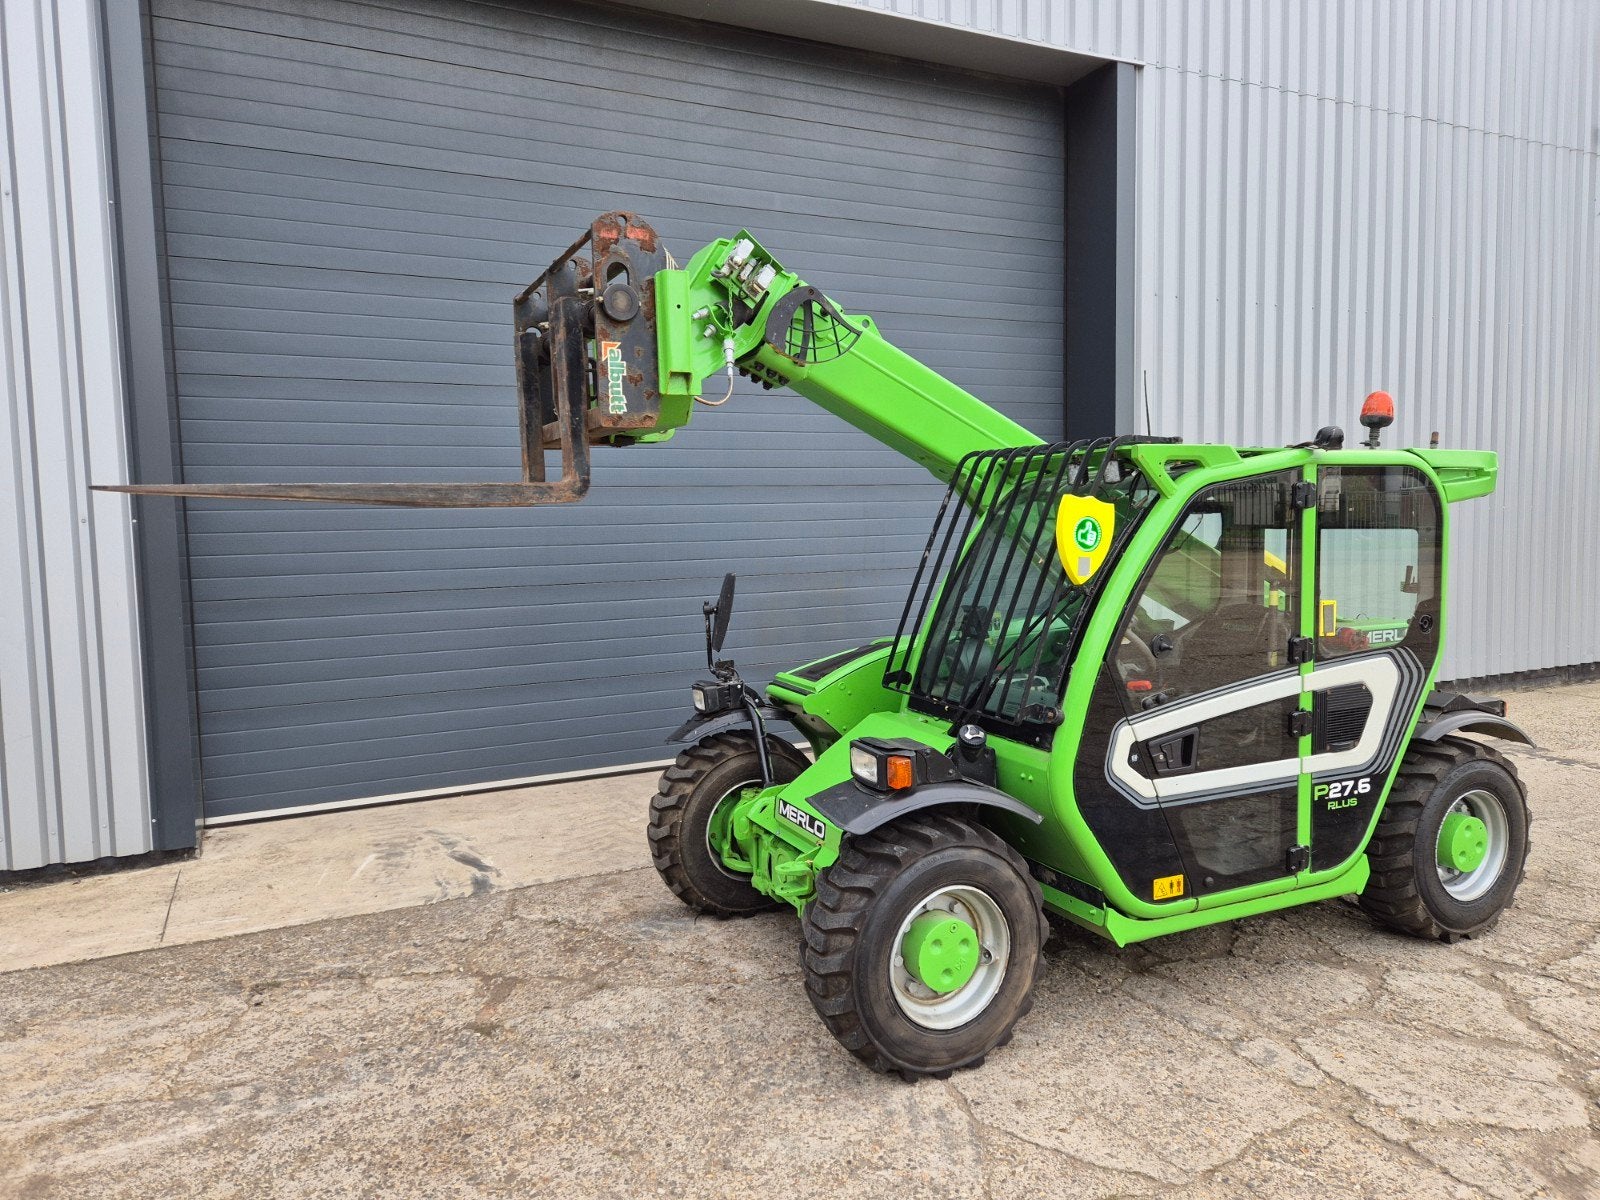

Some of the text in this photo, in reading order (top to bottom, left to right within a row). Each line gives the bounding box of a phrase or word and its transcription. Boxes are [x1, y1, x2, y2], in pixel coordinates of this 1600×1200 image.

[608, 348, 627, 414] albutt
[1367, 628, 1407, 643] ERL
[1314, 777, 1371, 801] P27.6
[779, 799, 825, 839] MERLO
